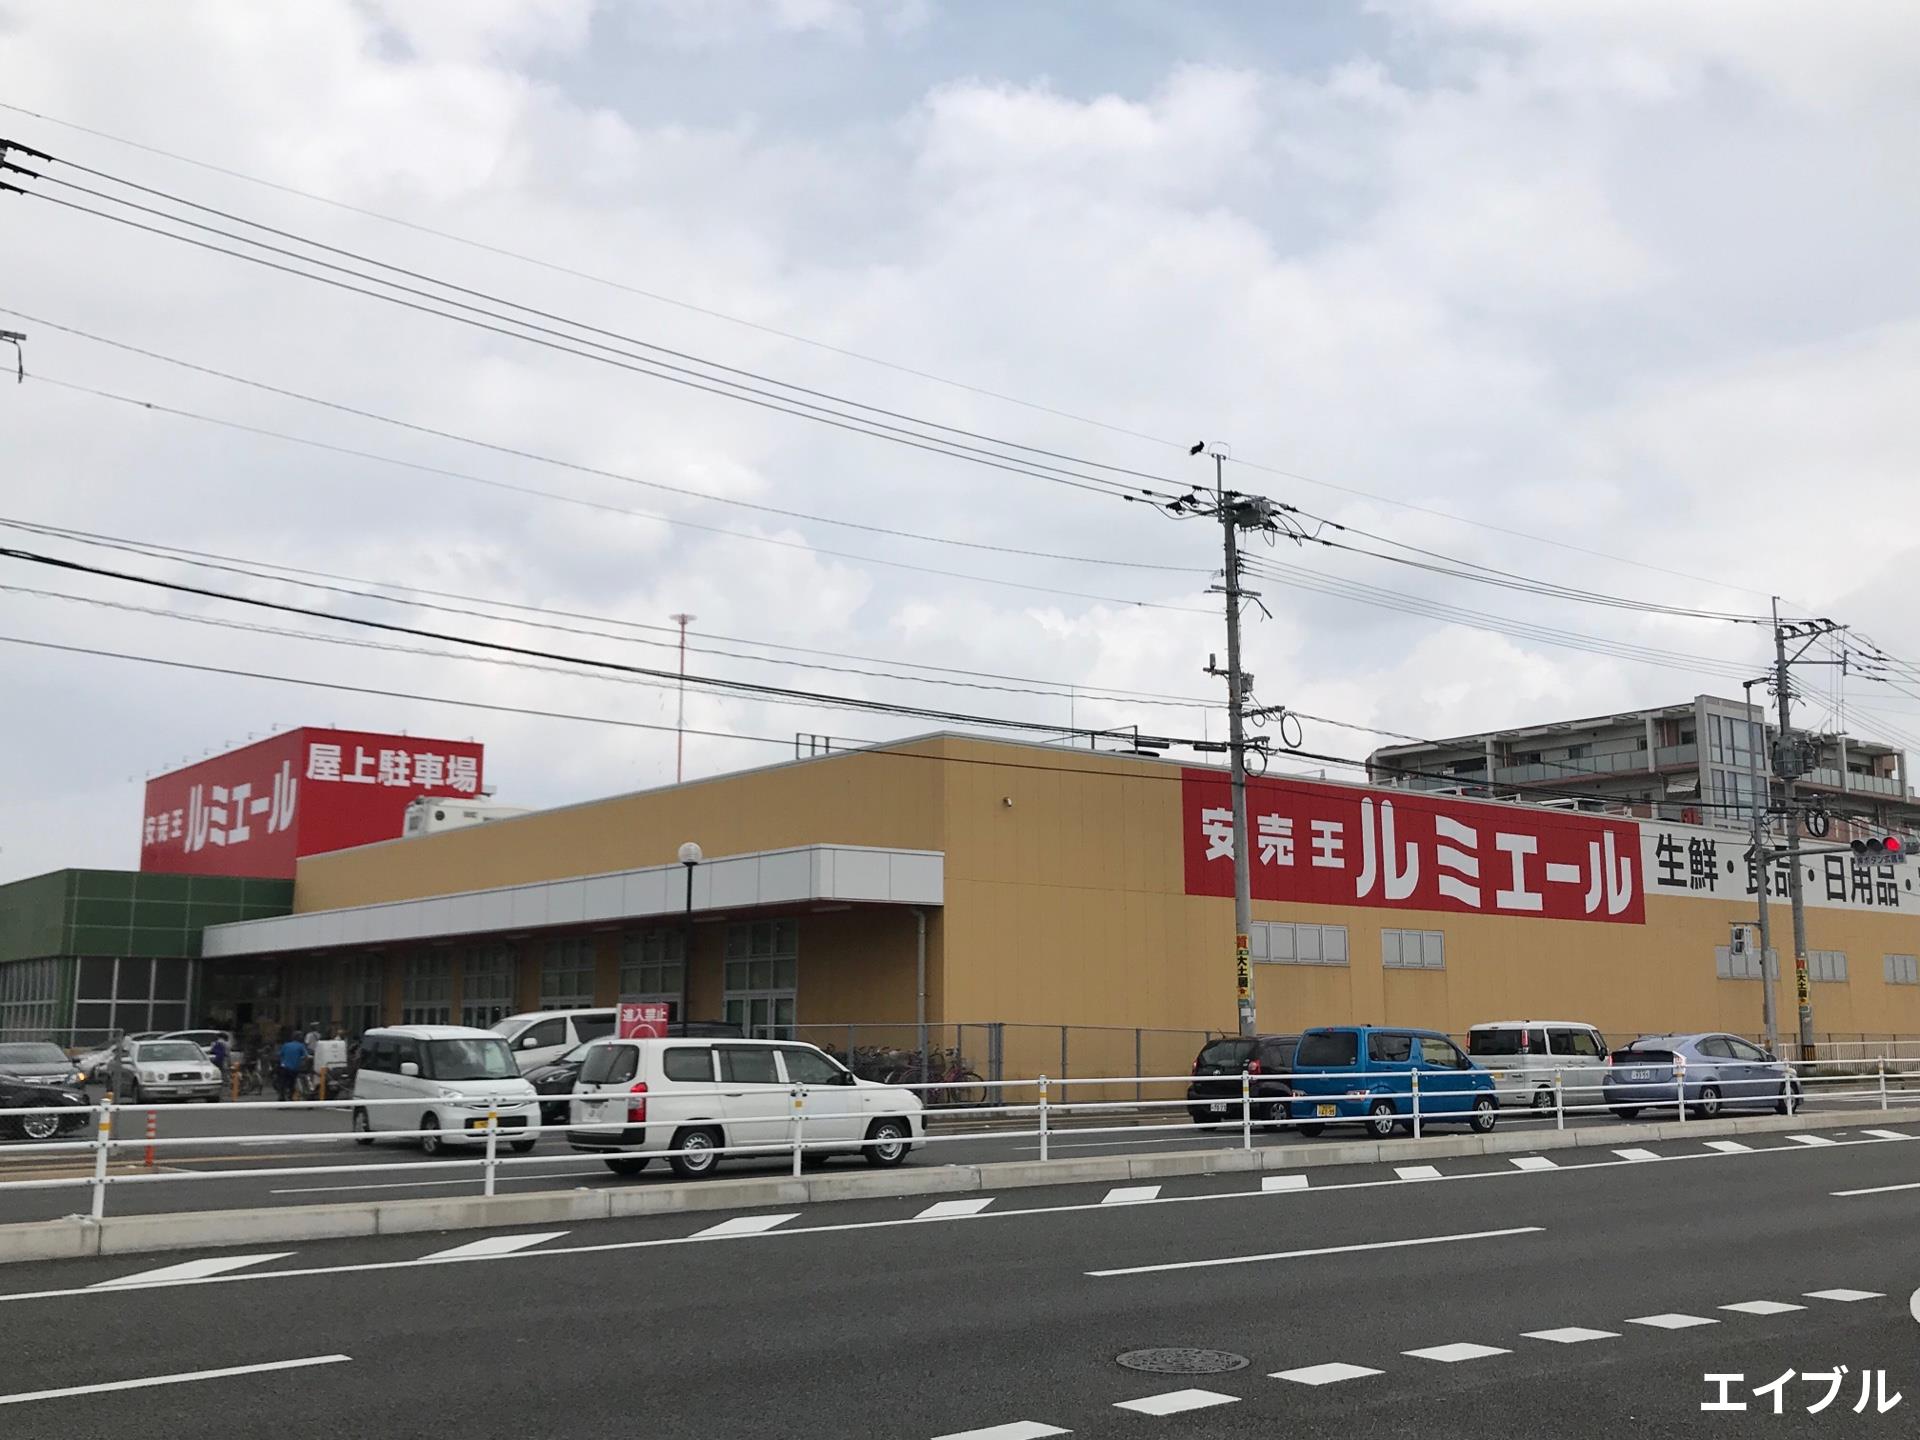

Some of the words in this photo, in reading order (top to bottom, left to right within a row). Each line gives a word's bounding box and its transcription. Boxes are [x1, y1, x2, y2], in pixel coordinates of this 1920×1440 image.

[184, 760, 297, 854] ルミエール
[306, 743, 478, 792] 屋上駐車場
[1202, 807, 1345, 869] 安売王
[1356, 797, 1633, 915] ルミエール
